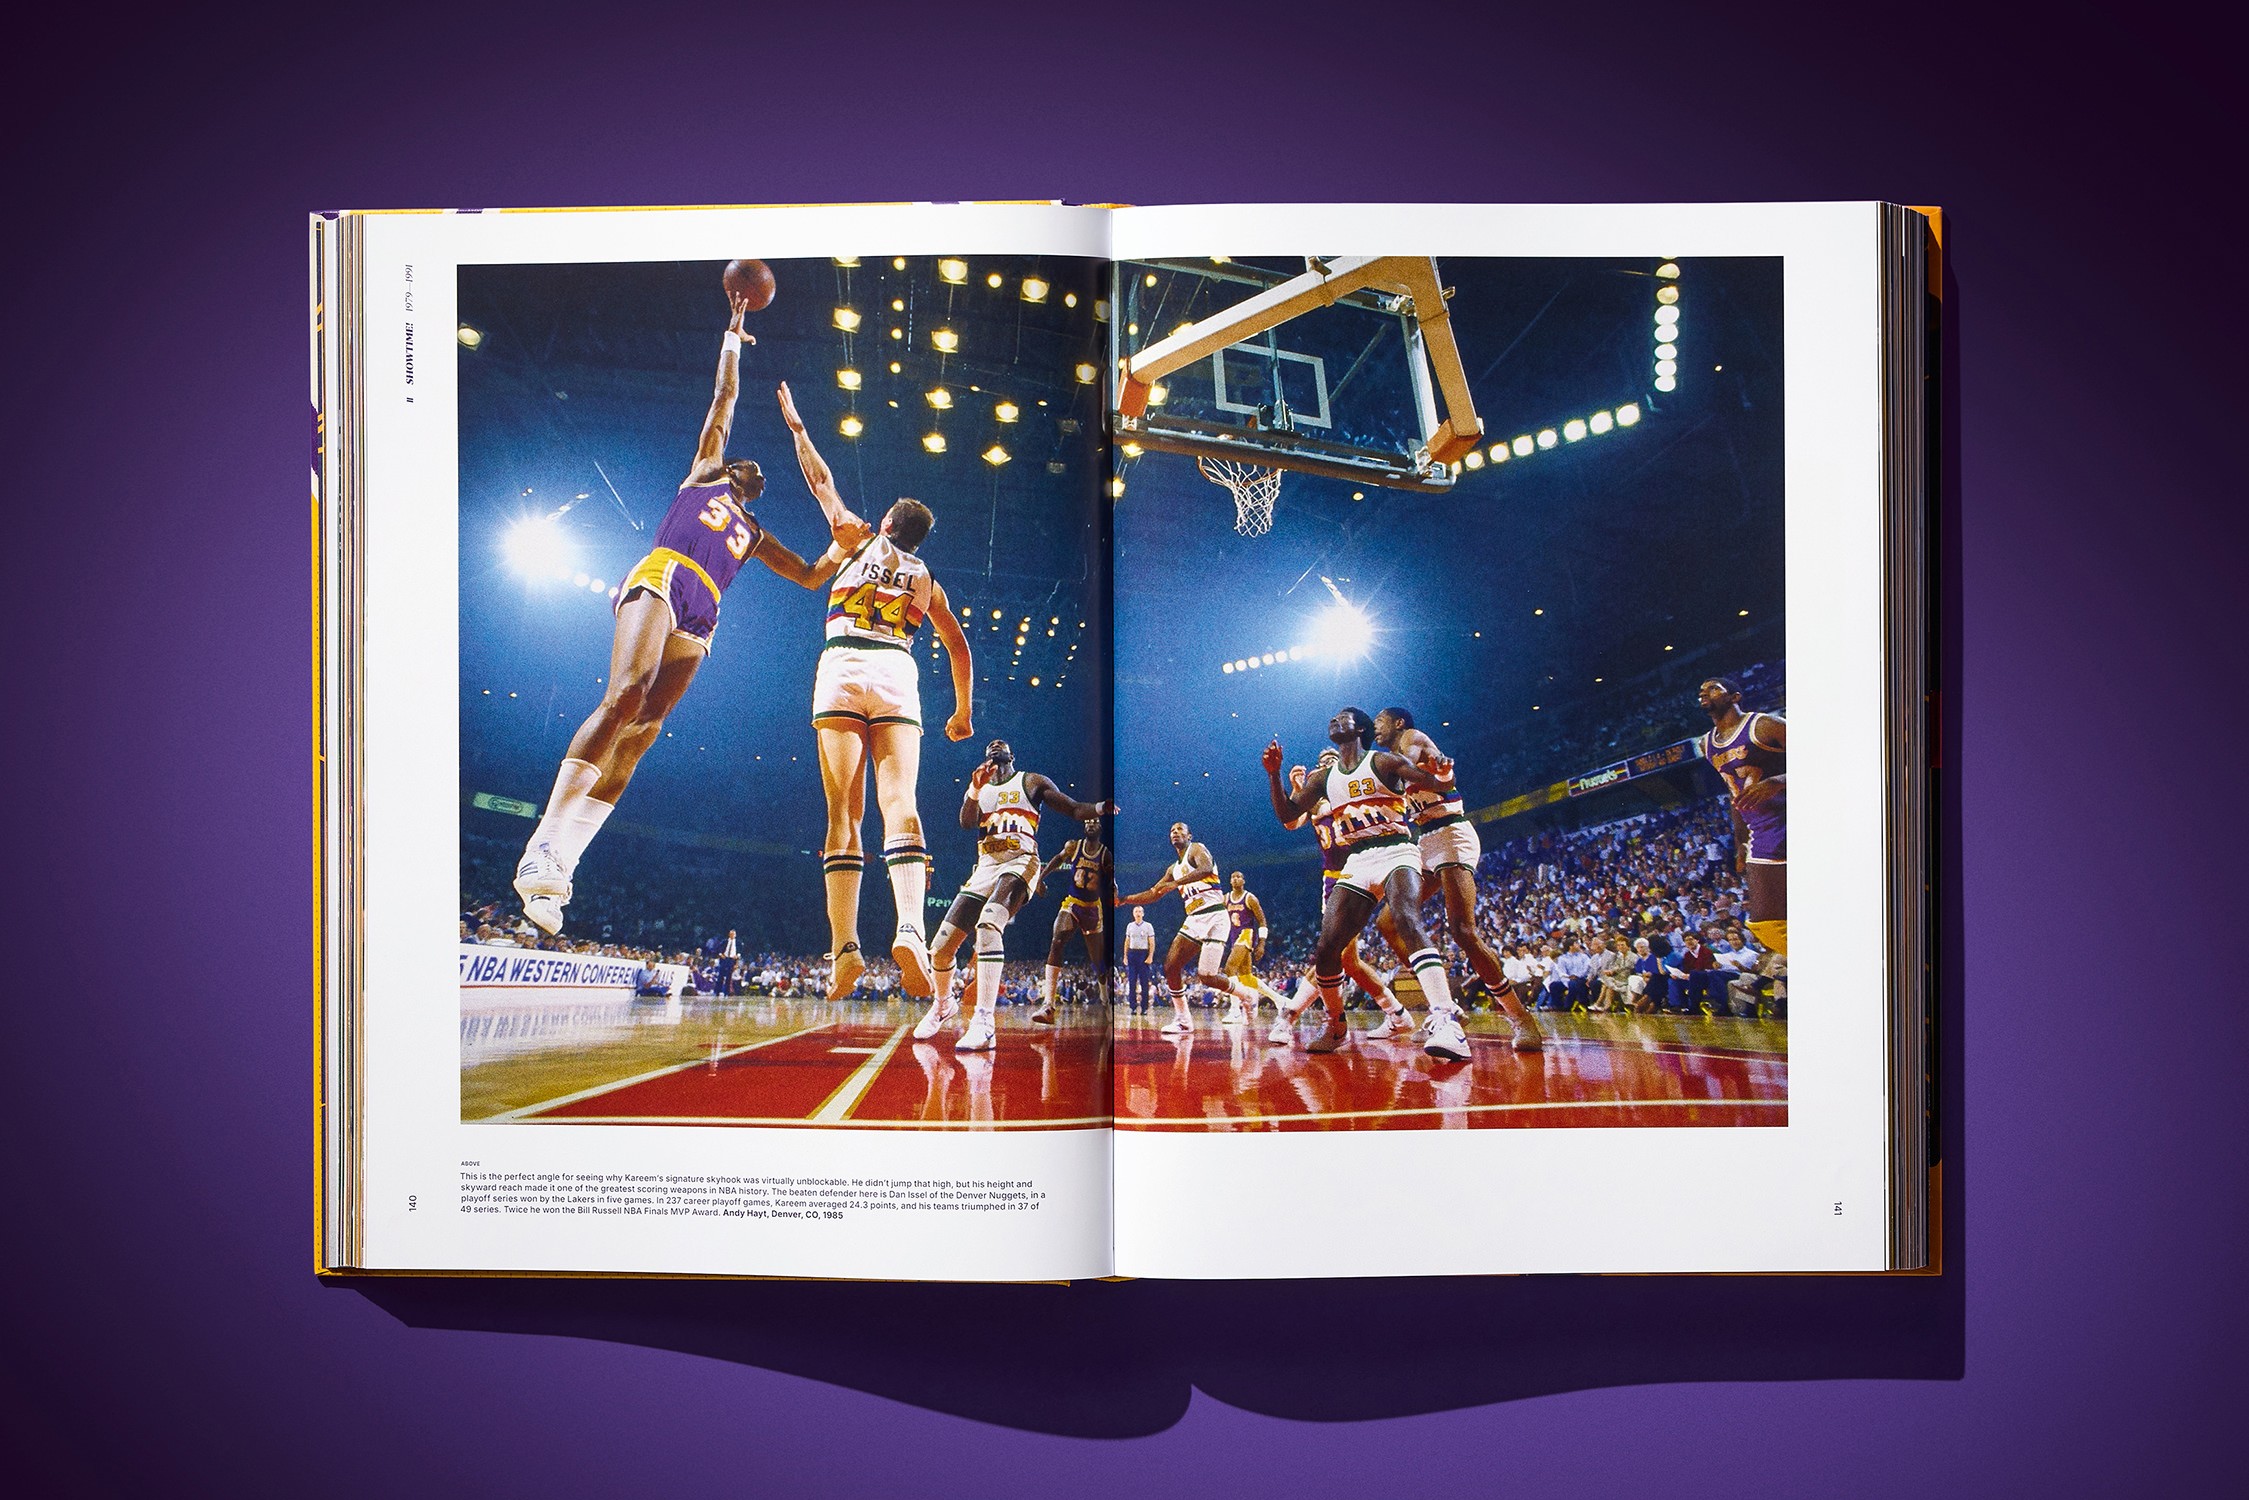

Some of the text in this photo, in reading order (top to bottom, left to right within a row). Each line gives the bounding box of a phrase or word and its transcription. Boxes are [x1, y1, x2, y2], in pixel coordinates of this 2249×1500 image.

[405, 322, 414, 386] SHOWTIME!
[698, 497, 751, 561] 33
[861, 562, 916, 593] ISSEL
[842, 582, 915, 641] 44
[1347, 777, 1377, 799] 23
[997, 790, 1021, 806] 33
[466, 955, 508, 982] NBA
[509, 957, 582, 984] WESTERN
[582, 963, 640, 985] CONFEREN
[460, 1172, 478, 1180] This
[480, 1172, 487, 1180] is
[488, 1172, 503, 1181] the
[504, 1172, 535, 1183] perfect
[536, 1172, 560, 1184] angle
[562, 1173, 574, 1181] for
[576, 1173, 604, 1184] seeing
[606, 1173, 623, 1184] why
[666, 1174, 705, 1185] signature
[706, 1175, 742, 1186] skyhook
[762, 1175, 795, 1187] virtually
[796, 1176, 850, 1186] unblockable.
[852, 1178, 864, 1186] He
[890, 1178, 913, 1189] jump
[914, 1178, 931, 1187] that
[932, 1179, 954, 1190] high,
[956, 1179, 970, 1187] but
[972, 1179, 985, 1187] his
[986, 1179, 1015, 1190] height
[1016, 1179, 1033, 1188] and
[460, 1183, 497, 1194] skyward
[498, 1183, 523, 1192] reach
[524, 1183, 548, 1192] made
[550, 1184, 556, 1192] it
[574, 1184, 584, 1193] of
[585, 1184, 599, 1193] the
[600, 1184, 635, 1196] greatest
[637, 1185, 668, 1196] scoring
[670, 1187, 708, 1197] weapons
[709, 1186, 717, 1194] in
[718, 1186, 737, 1195] NBA
[738, 1186, 770, 1197] history.
[772, 1187, 788, 1196] The
[789, 1187, 818, 1196] beaten
[819, 1188, 857, 1197] defender
[859, 1189, 879, 1197] here
[880, 1189, 888, 1198] is
[889, 1189, 906, 1198] Dan
[908, 1189, 928, 1198] Issel
[929, 1190, 938, 1198] of
[940, 1190, 954, 1198] the
[956, 1190, 987, 1199] Denver
[989, 1190, 1029, 1201] Nuggets,
[1030, 1190, 1039, 1199] in
[408, 1194, 418, 1212] 140
[460, 1205, 472, 1213] 49
[474, 1205, 502, 1214] series.
[504, 1205, 529, 1214] Twice
[530, 1205, 541, 1214] he
[562, 1206, 576, 1214] the
[578, 1206, 591, 1214] Bill
[592, 1206, 622, 1215] Russell
[624, 1206, 643, 1215] NBA
[644, 1207, 669, 1216] Finals
[670, 1207, 691, 1216] MVP
[692, 1207, 721, 1216] Award.
[722, 1208, 746, 1219] Andy
[746, 1208, 770, 1219] Hayt,
[771, 1209, 804, 1219] Denver,
[805, 1209, 821, 1219] CO,
[823, 1210, 844, 1219] 1985
[461, 1194, 491, 1205] playoff
[492, 1194, 519, 1203] series
[540, 1195, 550, 1206] by
[552, 1195, 566, 1204] the
[567, 1195, 596, 1204] Lakers
[597, 1195, 605, 1204] in
[606, 1196, 623, 1204] five
[624, 1198, 655, 1207] games.
[656, 1196, 665, 1205] In
[666, 1196, 682, 1205] 237
[712, 1197, 741, 1208] playoff
[742, 1199, 773, 1209] games,
[775, 1198, 807, 1207] Kareem
[808, 1199, 848, 1211] averaged
[850, 1200, 869, 1209] 24.3
[870, 1200, 899, 1211] points,
[900, 1200, 917, 1209] and
[919, 1201, 932, 1209] his
[933, 1201, 960, 1210] teams
[961, 1201, 1006, 1212] triumphed
[1008, 1201, 1016, 1210] in
[1018, 1201, 1029, 1210] 37
[1030, 1201, 1040, 1210] of
[1834, 1201, 1843, 1216] 141
